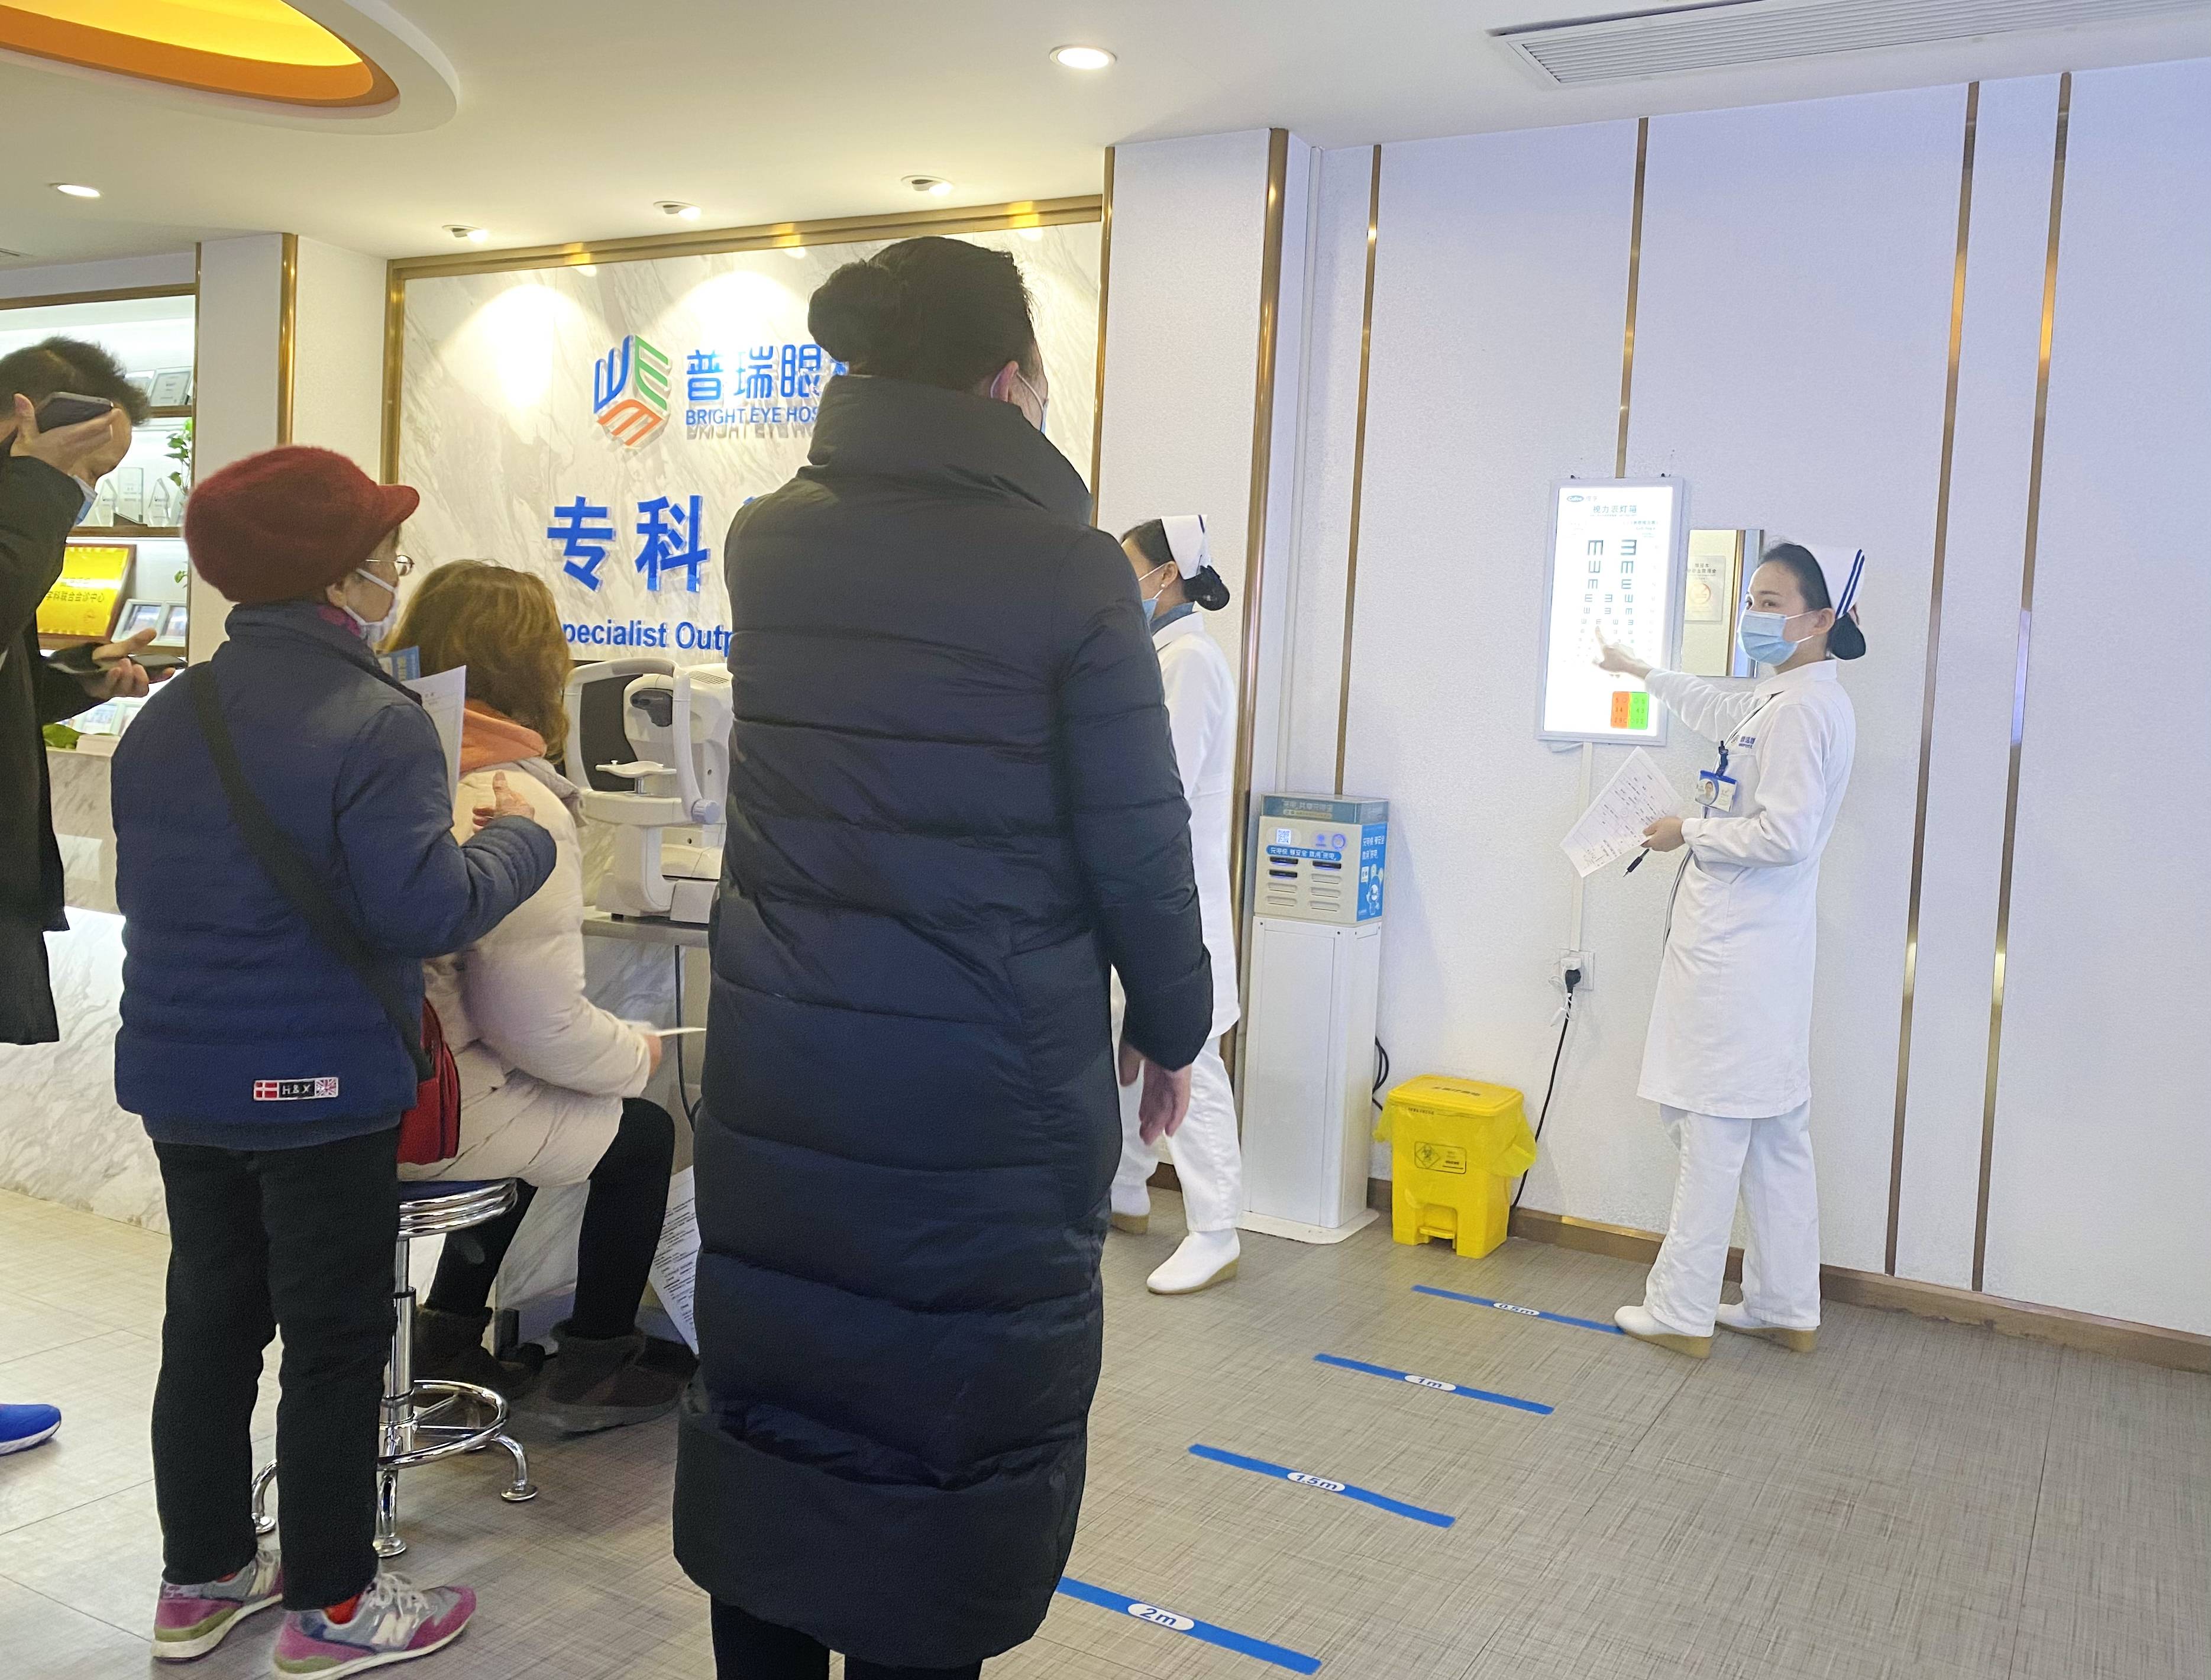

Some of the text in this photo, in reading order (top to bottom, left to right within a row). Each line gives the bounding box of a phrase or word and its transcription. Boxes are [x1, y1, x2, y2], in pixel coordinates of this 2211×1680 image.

[686, 344, 849, 401] 普瑞眼
[686, 408, 746, 425] BRIGHT
[750, 406, 782, 423] EYE
[547, 495, 759, 593] 专科
[1498, 1304, 1534, 1314] 0.5m
[1418, 1378, 1442, 1388] 1m
[1296, 1475, 1338, 1490] 1.5m
[1139, 1608, 1177, 1626] 2m
